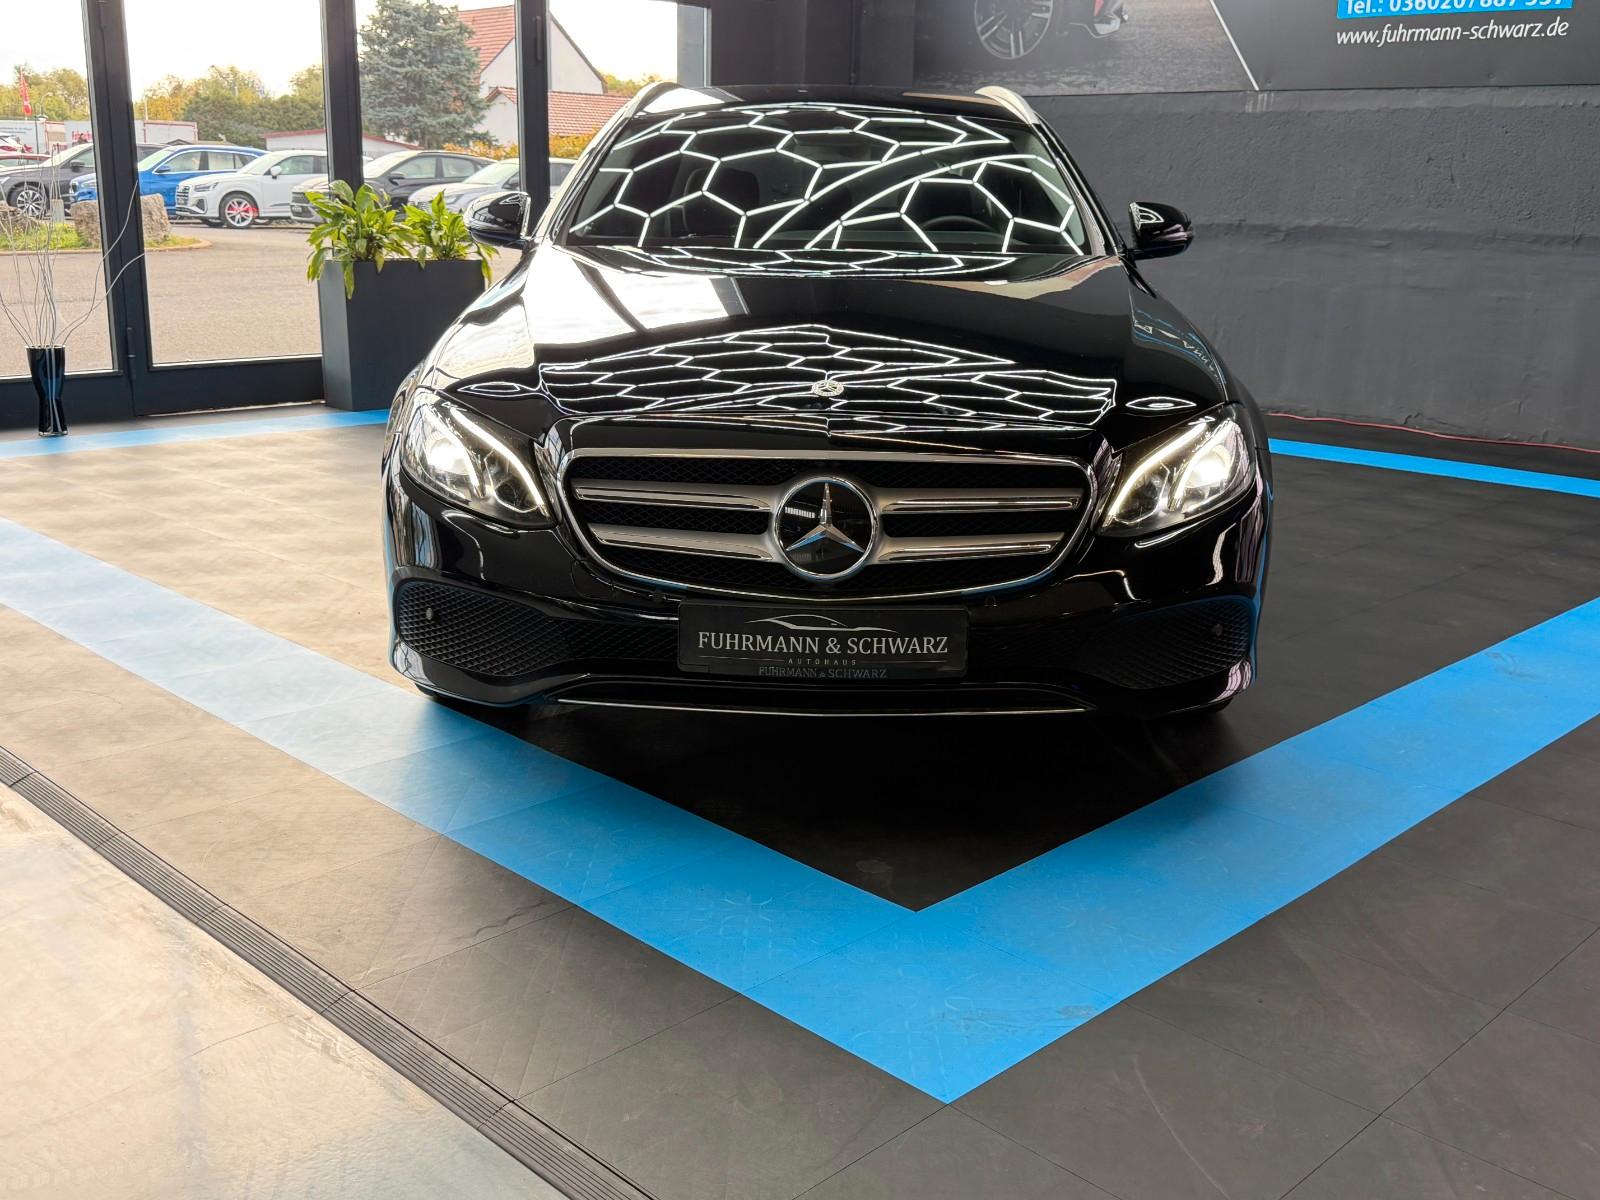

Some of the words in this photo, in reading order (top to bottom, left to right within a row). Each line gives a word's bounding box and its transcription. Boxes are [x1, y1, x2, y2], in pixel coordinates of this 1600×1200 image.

[1337, 16, 1569, 47] www.fuhrmann-schwarz.de
[697, 631, 820, 654] FUHRMANN
[825, 637, 842, 654] &
[847, 636, 948, 655] SCHWARZ
[788, 658, 856, 666] AUTOHAUS
[759, 666, 817, 678] FUHRMANN
[828, 668, 888, 679] SCHWARZ
